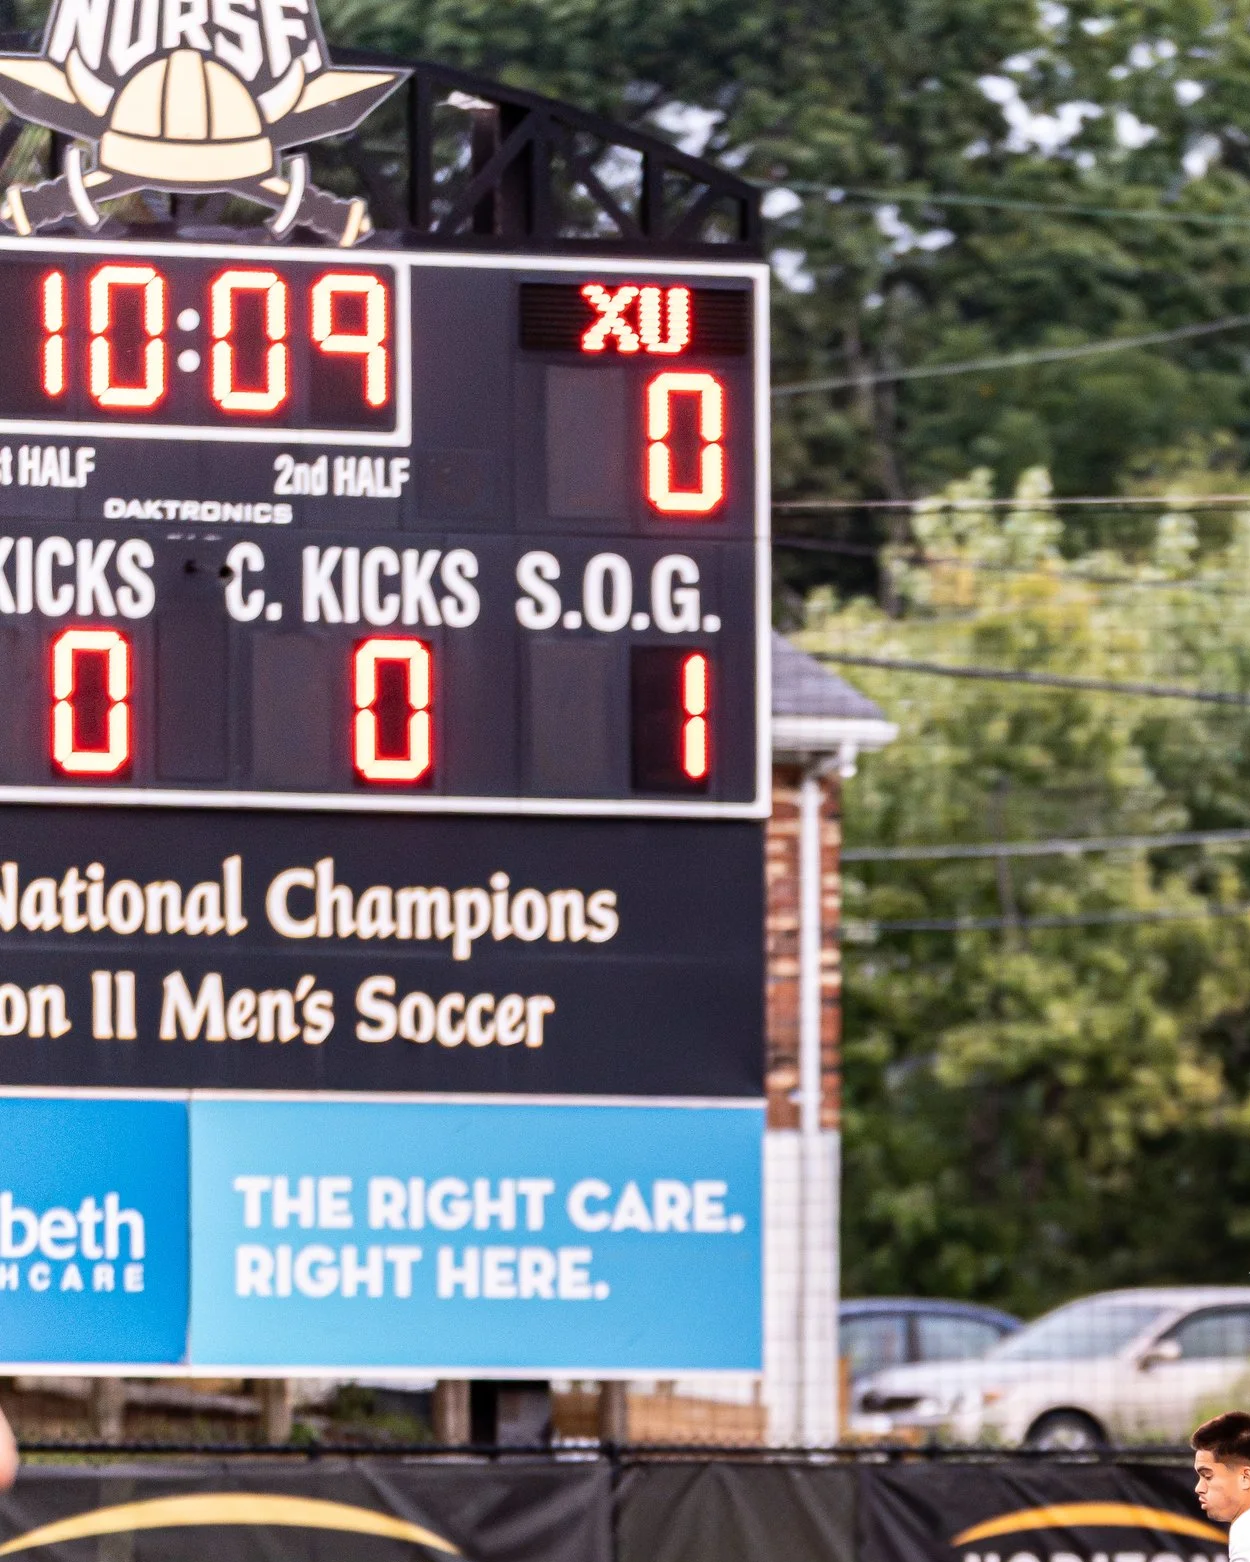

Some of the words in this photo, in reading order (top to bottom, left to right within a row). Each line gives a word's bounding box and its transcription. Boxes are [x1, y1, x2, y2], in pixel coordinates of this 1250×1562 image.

[49, 0, 322, 82] NORSE
[42, 264, 390, 413] 10:09
[580, 284, 693, 354] XU
[18, 444, 96, 488] HALF
[273, 454, 328, 496] 2nd
[333, 456, 411, 498] HALF
[646, 370, 725, 515] 0
[103, 497, 293, 525] DAKTRONICS
[225, 541, 283, 622] C.
[302, 545, 481, 629] KICKS
[515, 550, 721, 634] S.O.G.
[52, 629, 130, 773] 0
[353, 639, 432, 782] 0
[682, 653, 709, 780] 1
[266, 858, 619, 961] Champions
[0, 983, 72, 1039] on
[91, 970, 137, 1040] II
[160, 971, 335, 1044] Men's
[355, 975, 555, 1047] Soccer
[0, 1190, 145, 1260] beth
[232, 1175, 353, 1229] THE
[367, 1176, 555, 1231] RIGHT
[566, 1179, 745, 1233] CARE.
[0, 1262, 145, 1293] HCARE
[234, 1244, 422, 1298] RIGHT
[436, 1245, 610, 1300] HERE.
